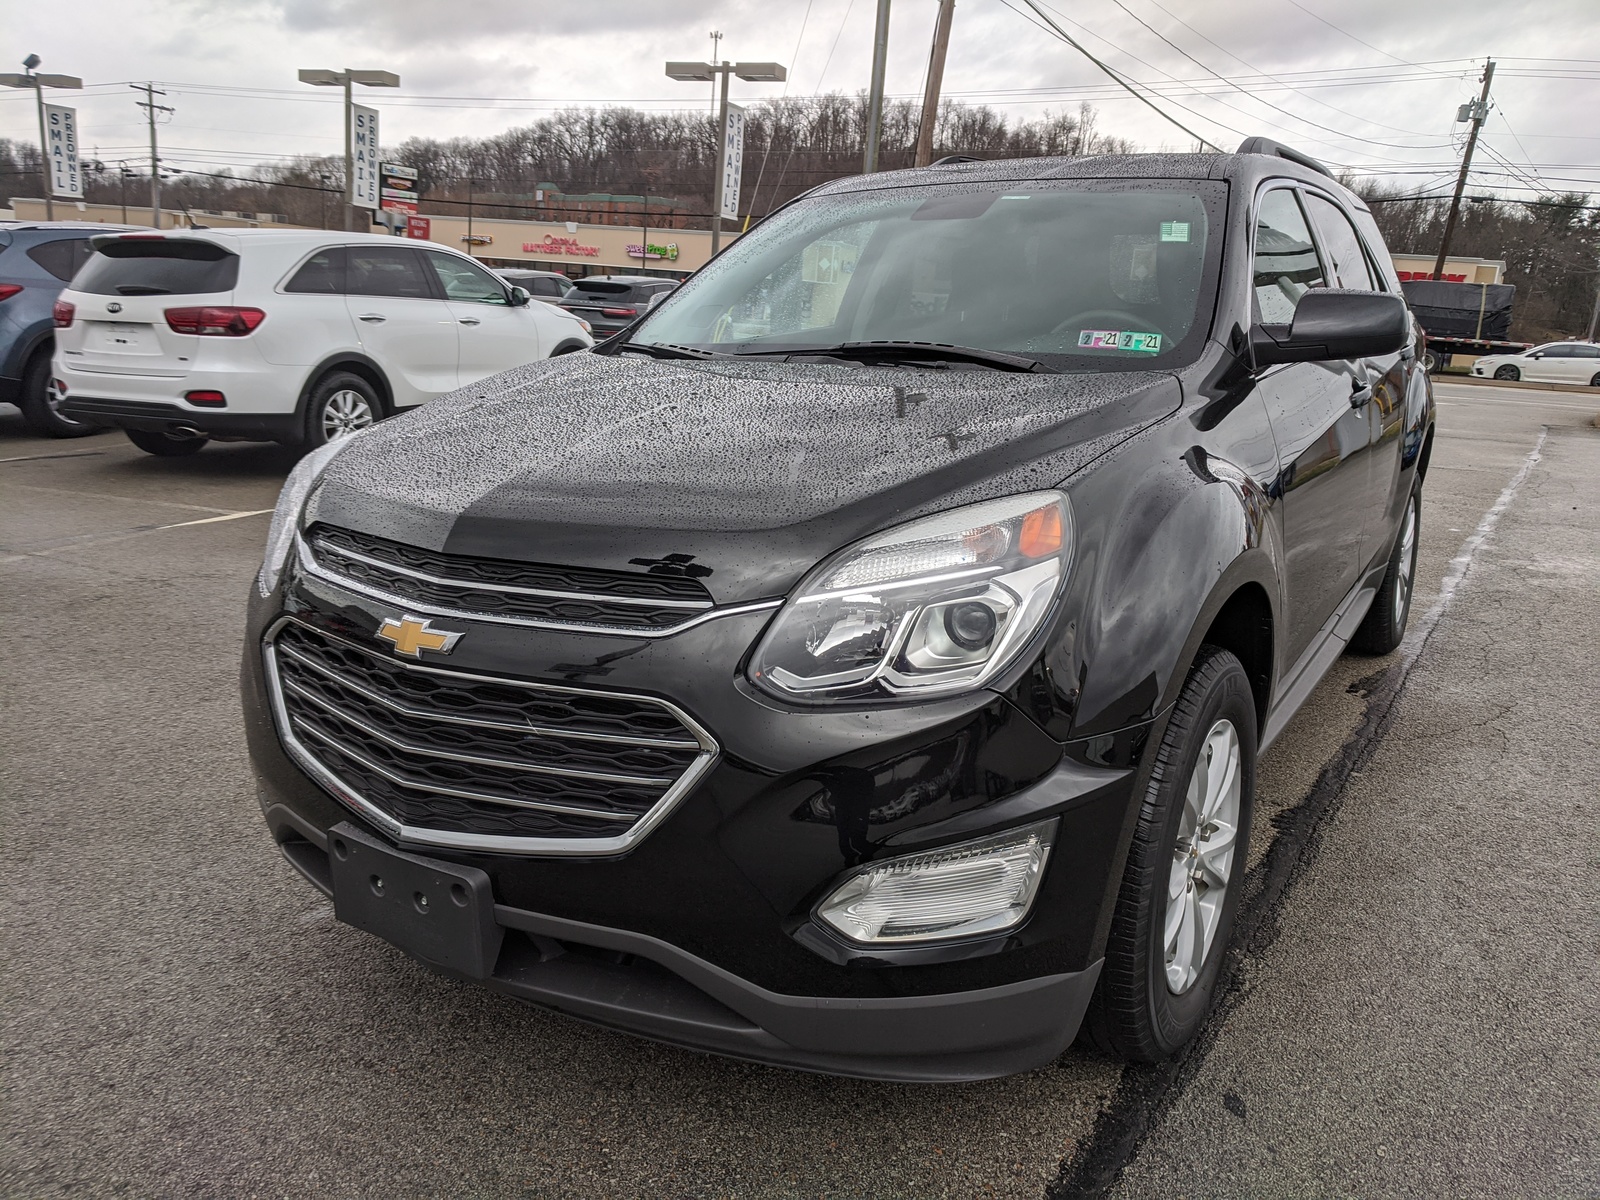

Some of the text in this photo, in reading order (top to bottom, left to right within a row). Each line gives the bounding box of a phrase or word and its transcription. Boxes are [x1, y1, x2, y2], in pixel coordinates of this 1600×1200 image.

[50, 113, 65, 189] SMAIL
[64, 112, 78, 192] PREOWNED
[356, 114, 365, 198] SMAIL
[367, 114, 376, 202] PREOWNED
[724, 113, 735, 208] SMAIL
[730, 113, 742, 213] PREOWNED
[1105, 332, 1117, 345] 21
[1145, 335, 1158, 349] 21
